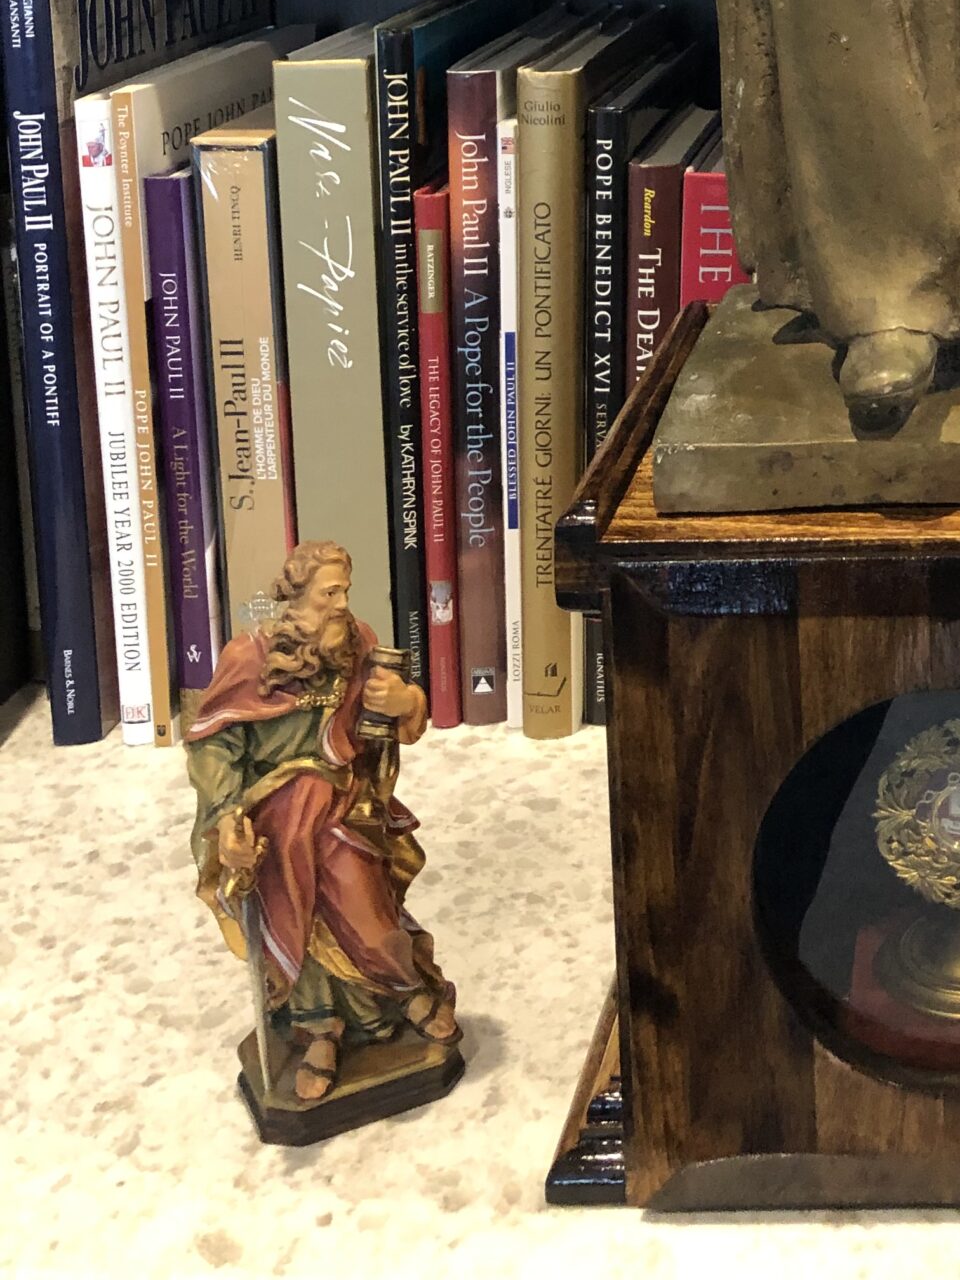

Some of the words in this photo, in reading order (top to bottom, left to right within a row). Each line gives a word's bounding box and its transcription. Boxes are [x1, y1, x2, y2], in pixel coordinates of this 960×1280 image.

[383, 69, 409, 140] JOHN
[13, 111, 45, 161] JOHN
[388, 149, 411, 213] PAUL
[455, 131, 489, 190] John
[595, 139, 613, 200] POPE
[20, 163, 50, 211] PAUL
[25, 214, 54, 232] II
[462, 199, 491, 250] Paul
[643, 188, 656, 237] Reardon
[87, 205, 118, 288] JOHN
[395, 243, 412, 259] in
[463, 256, 489, 276] II
[33, 242, 53, 317] PORTRAIT
[395, 263, 414, 289] the
[426, 244, 436, 299] RATZINGER
[533, 202, 552, 338] PONTIFICATO
[594, 213, 612, 342] BENEDICT
[637, 247, 662, 299] THE
[159, 272, 180, 328] JOHN
[464, 288, 489, 308] A
[40, 323, 54, 343] OF
[98, 301, 124, 371] PAUL
[397, 293, 416, 351] service
[42, 350, 54, 360] A
[165, 335, 184, 382] PAUL
[260, 337, 272, 381] MONDE
[398, 354, 416, 371] of
[457, 317, 490, 376] Pope
[535, 351, 552, 381] UN
[104, 380, 126, 398] II
[399, 374, 417, 407] love
[428, 357, 439, 383] THE
[594, 353, 611, 392] XVI
[43, 364, 60, 427] PONTIFF
[135, 389, 149, 435] POPE
[169, 387, 185, 400] II
[428, 389, 441, 435] LEGACY
[465, 383, 493, 417] for
[398, 425, 414, 442] by
[430, 439, 441, 455] OF
[467, 423, 493, 464] the
[108, 431, 130, 501] JUBILEE
[137, 442, 153, 491] JOHN
[401, 443, 417, 509] KATHRYN
[431, 459, 443, 497] JOHN
[113, 506, 133, 552] YEAR
[142, 499, 157, 545] PAUL
[403, 510, 417, 550] SPINK
[432, 499, 444, 528] PAUL
[461, 469, 496, 548] People
[534, 475, 553, 588] TRENTATRÉ
[433, 532, 444, 543] II
[117, 560, 136, 596] 2000
[146, 555, 158, 568] II
[181, 549, 199, 600] World
[121, 601, 141, 673] EDITION
